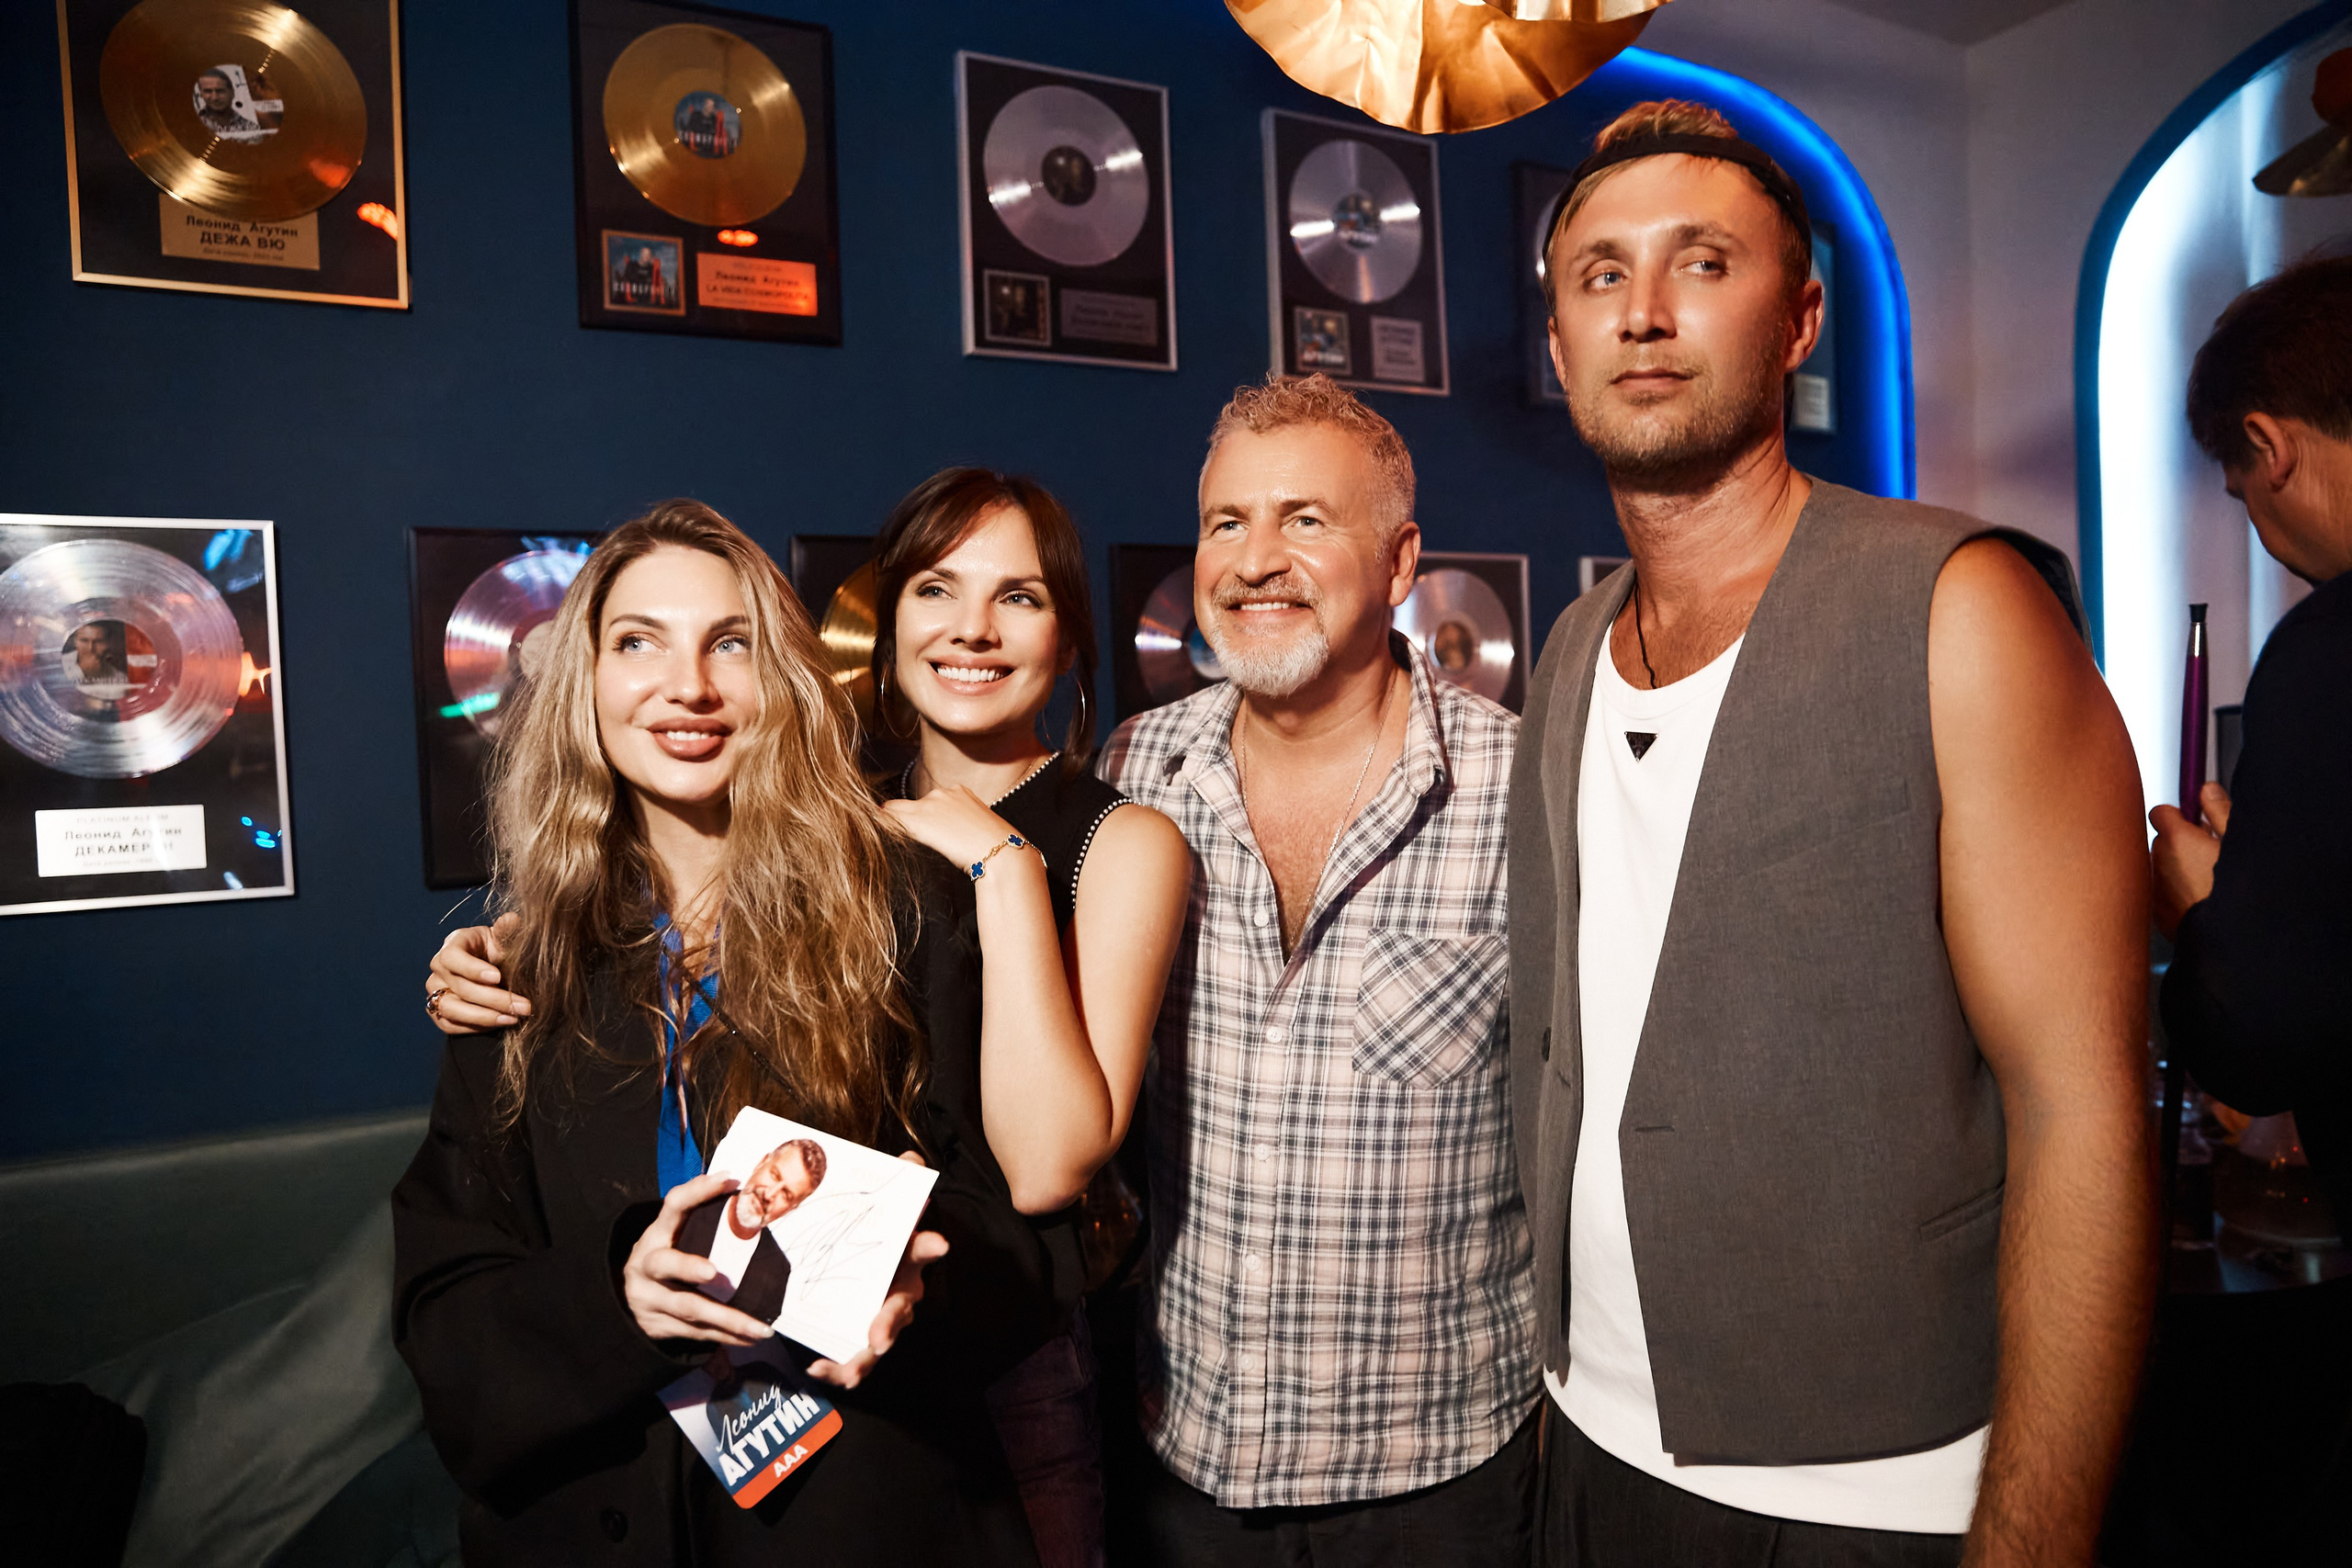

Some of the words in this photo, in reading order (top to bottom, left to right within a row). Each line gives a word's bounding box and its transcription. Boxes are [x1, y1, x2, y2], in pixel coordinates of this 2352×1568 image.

[250, 222, 299, 237] Агутин
[200, 231, 251, 247] ДЕЖА
[257, 237, 286, 251] ВЮ
[131, 827, 182, 839] Агин
[74, 841, 174, 857] ДЕКАМЕРН
[718, 1393, 820, 1486] АГУТИН
